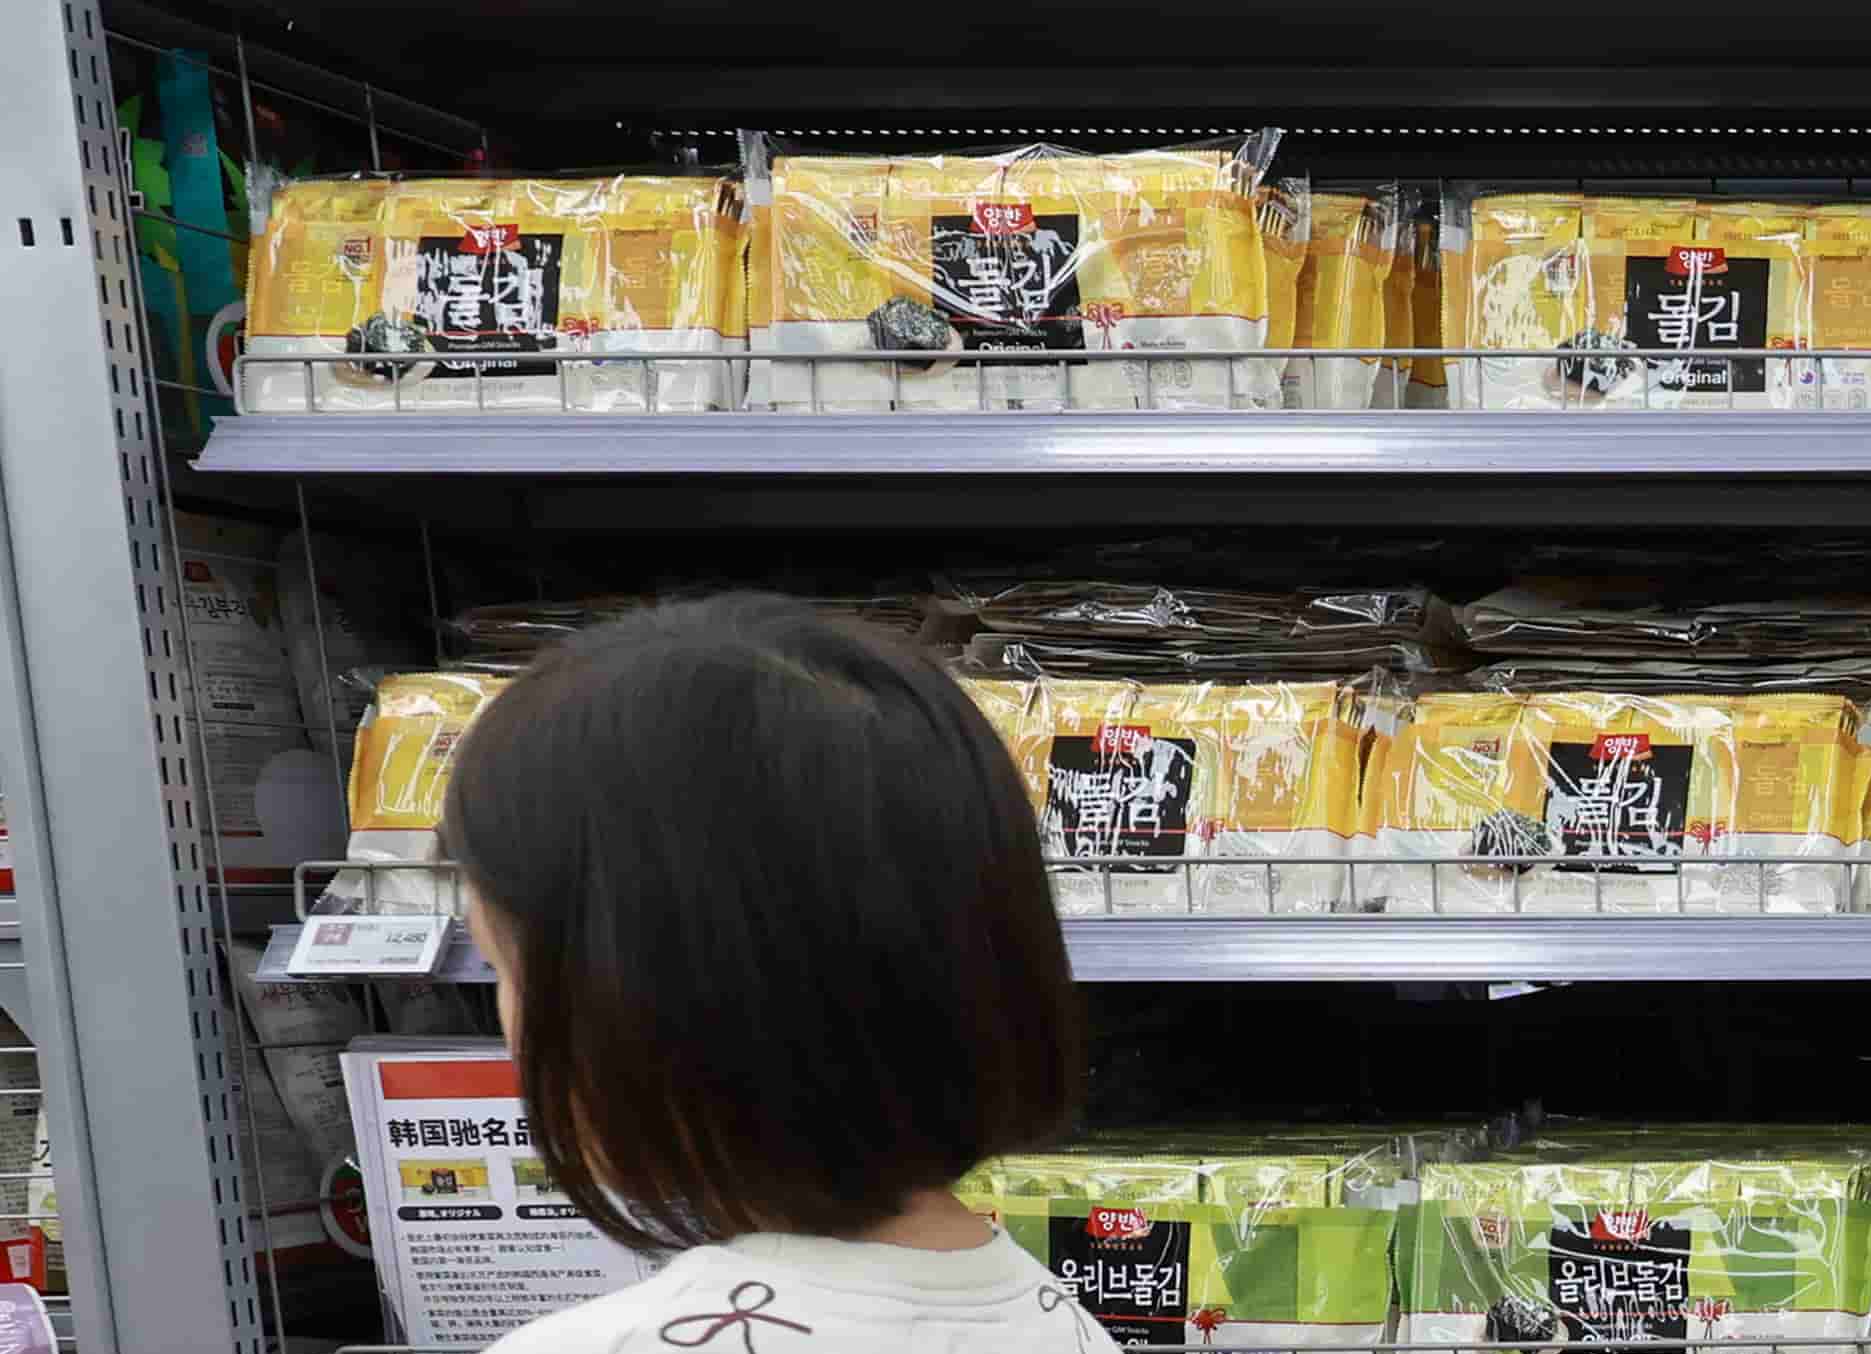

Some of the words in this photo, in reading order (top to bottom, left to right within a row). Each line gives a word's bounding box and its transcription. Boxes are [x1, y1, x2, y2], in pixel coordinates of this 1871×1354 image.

[1648, 293, 1739, 349] 돌김
[1058, 1261, 1183, 1308] 올리브돌김
[1554, 1258, 1688, 1308] 올리브돌김
